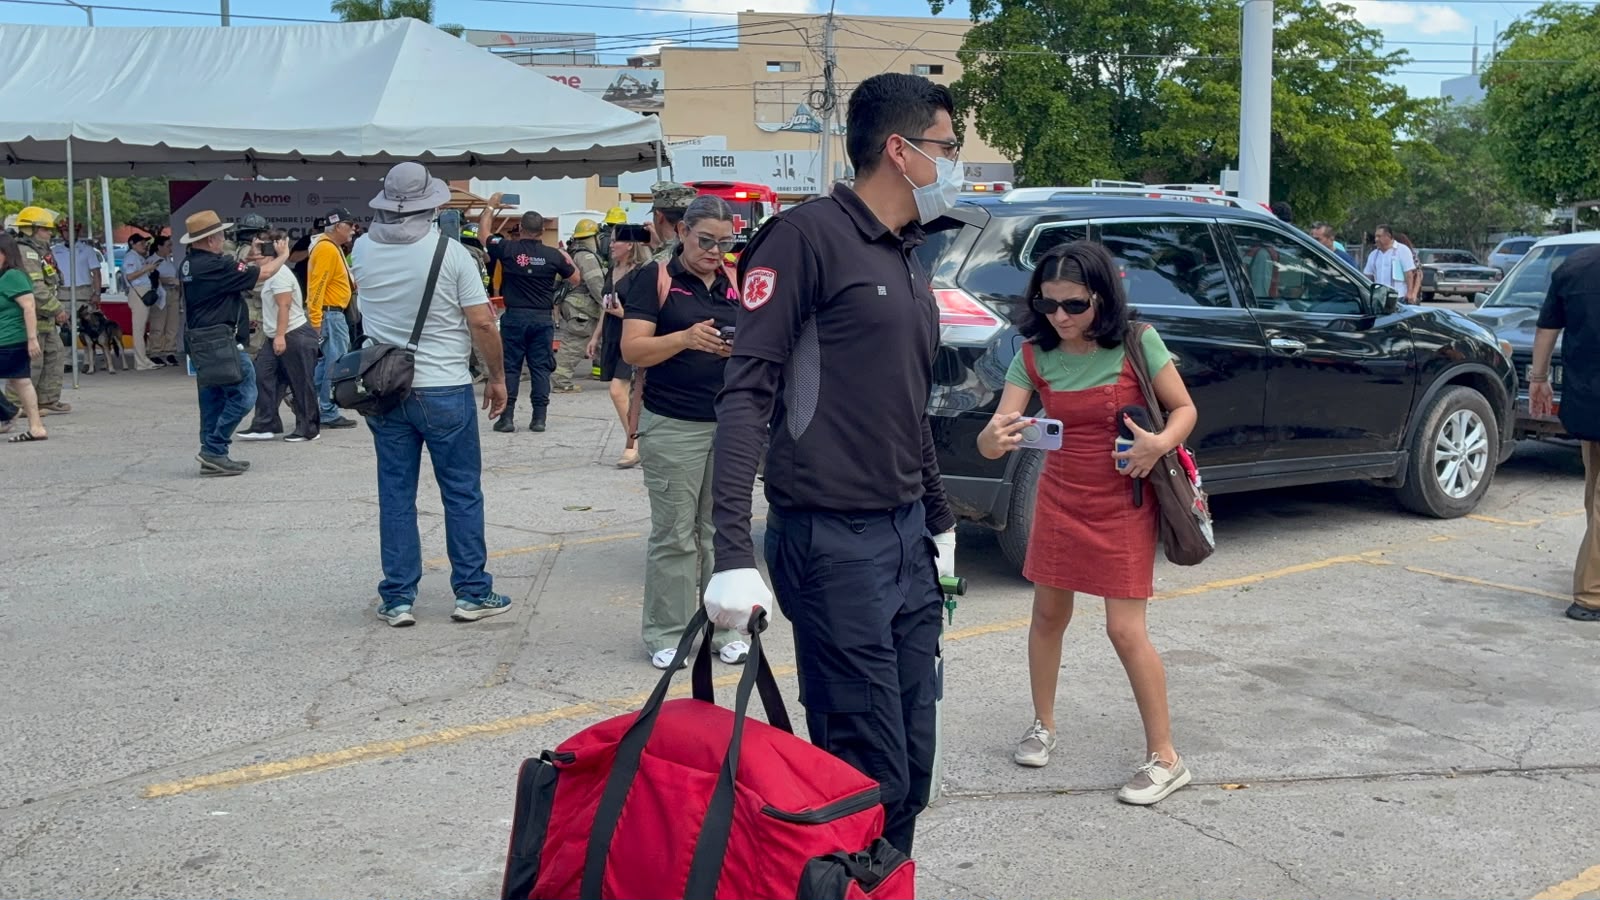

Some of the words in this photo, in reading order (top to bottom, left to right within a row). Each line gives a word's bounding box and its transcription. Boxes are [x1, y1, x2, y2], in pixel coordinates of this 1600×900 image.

[702, 156, 734, 167] MEGA
[964, 167, 981, 177] AS
[240, 192, 291, 209] Ahome
